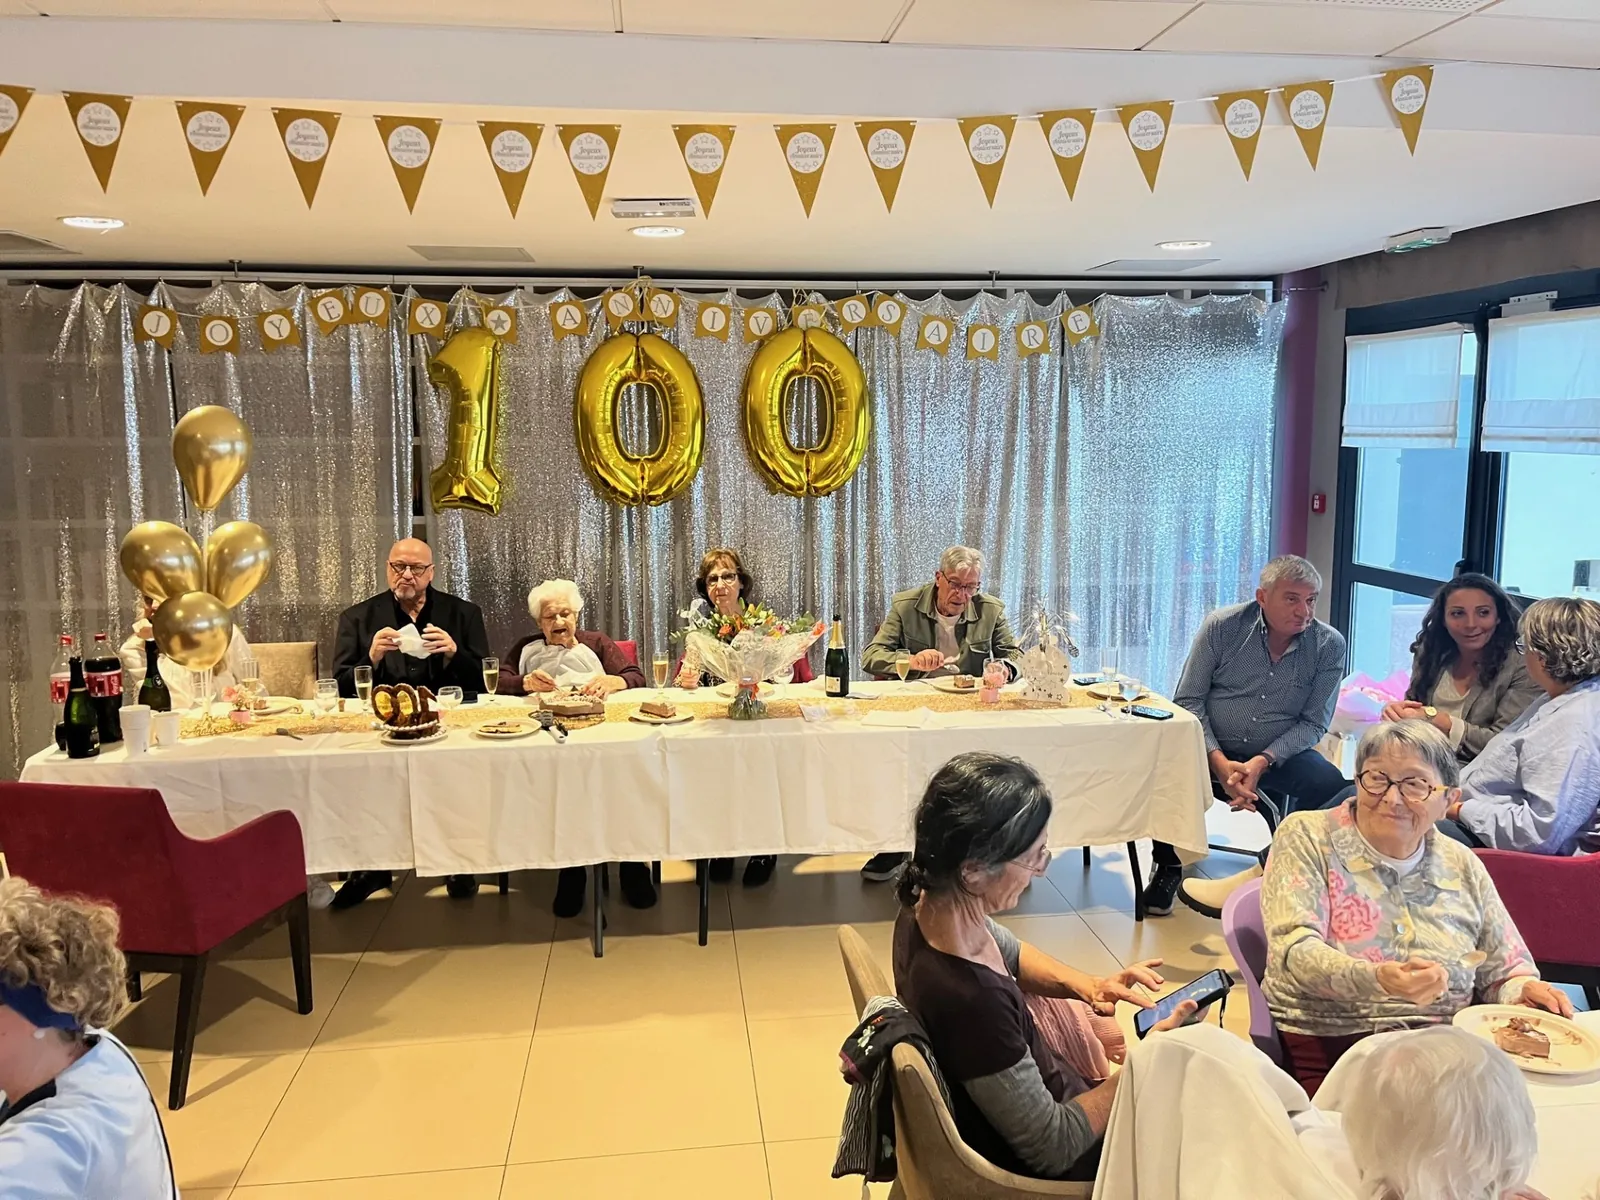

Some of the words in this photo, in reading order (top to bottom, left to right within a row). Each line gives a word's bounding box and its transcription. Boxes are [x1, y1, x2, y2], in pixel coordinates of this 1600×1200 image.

[1399, 88, 1419, 97] Joyeux
[1298, 103, 1319, 112] Joyeux
[1233, 112, 1253, 121] Joyeux
[1137, 124, 1157, 132] Joyeux
[1057, 131, 1079, 140] Joyeux
[398, 139, 421, 148] Joyeux
[977, 137, 999, 146] Joyeux
[501, 143, 523, 152] Joyeux
[579, 147, 601, 155] Joyeux
[693, 145, 716, 154] Joyeux
[795, 145, 818, 154] Joyeux
[876, 142, 898, 151] Joyeux
[149, 295, 438, 343] JOYEUX
[428, 326, 871, 515] 100
